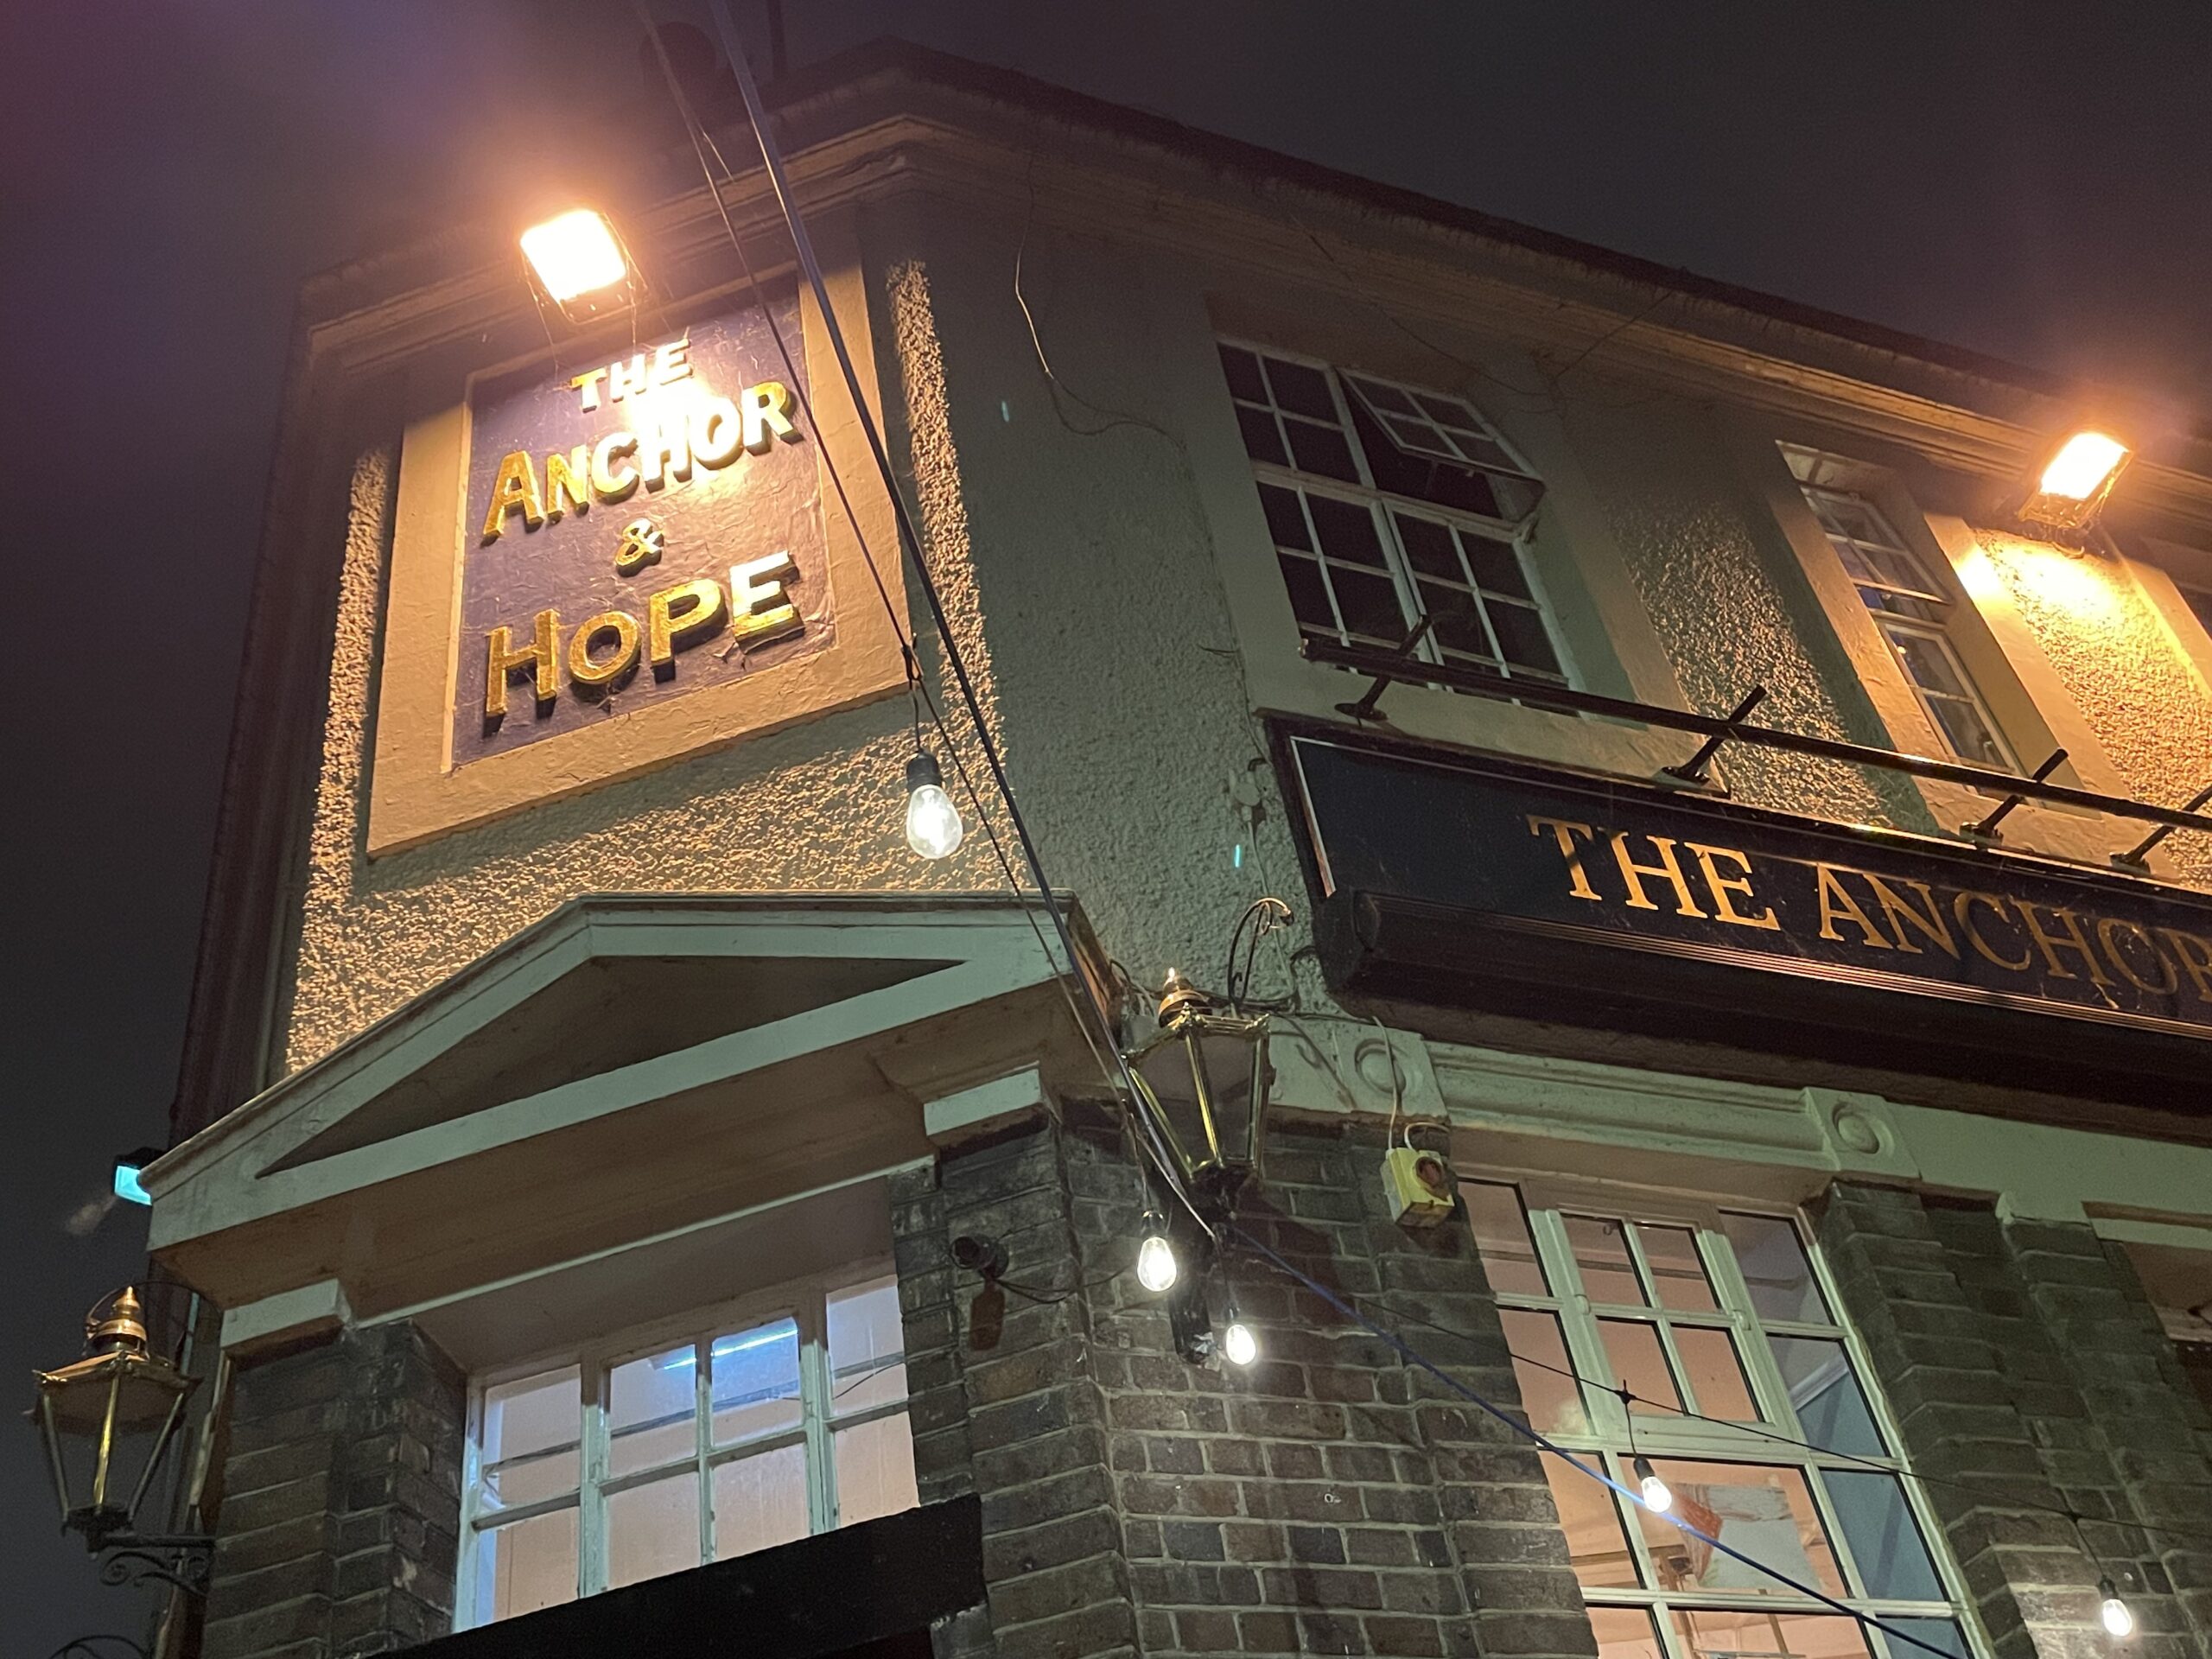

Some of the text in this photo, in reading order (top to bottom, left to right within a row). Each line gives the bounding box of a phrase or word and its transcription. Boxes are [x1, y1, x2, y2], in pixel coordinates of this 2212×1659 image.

[570, 338, 694, 411] THE
[481, 381, 804, 546] ANCHOR
[614, 518, 664, 575] &
[483, 551, 805, 734] HOPE
[1527, 815, 1780, 931] THE
